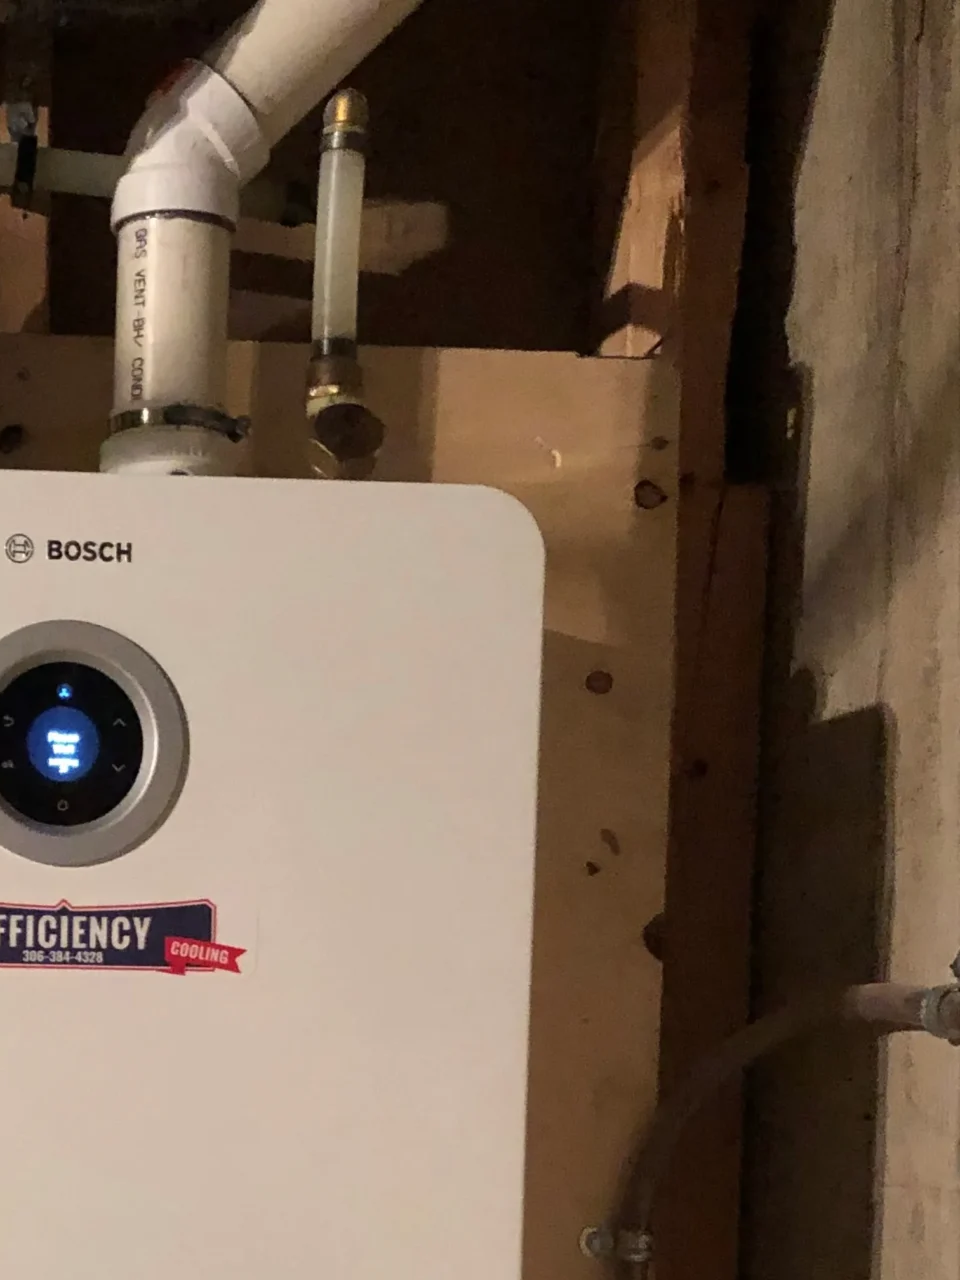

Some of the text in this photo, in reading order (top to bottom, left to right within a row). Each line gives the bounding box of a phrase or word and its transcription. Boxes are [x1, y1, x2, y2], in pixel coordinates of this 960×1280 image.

[134, 227, 148, 260] GAS
[47, 539, 133, 563] BOSCH
[21, 949, 105, 964] 306-384-4328
[169, 940, 230, 965] COOLING
